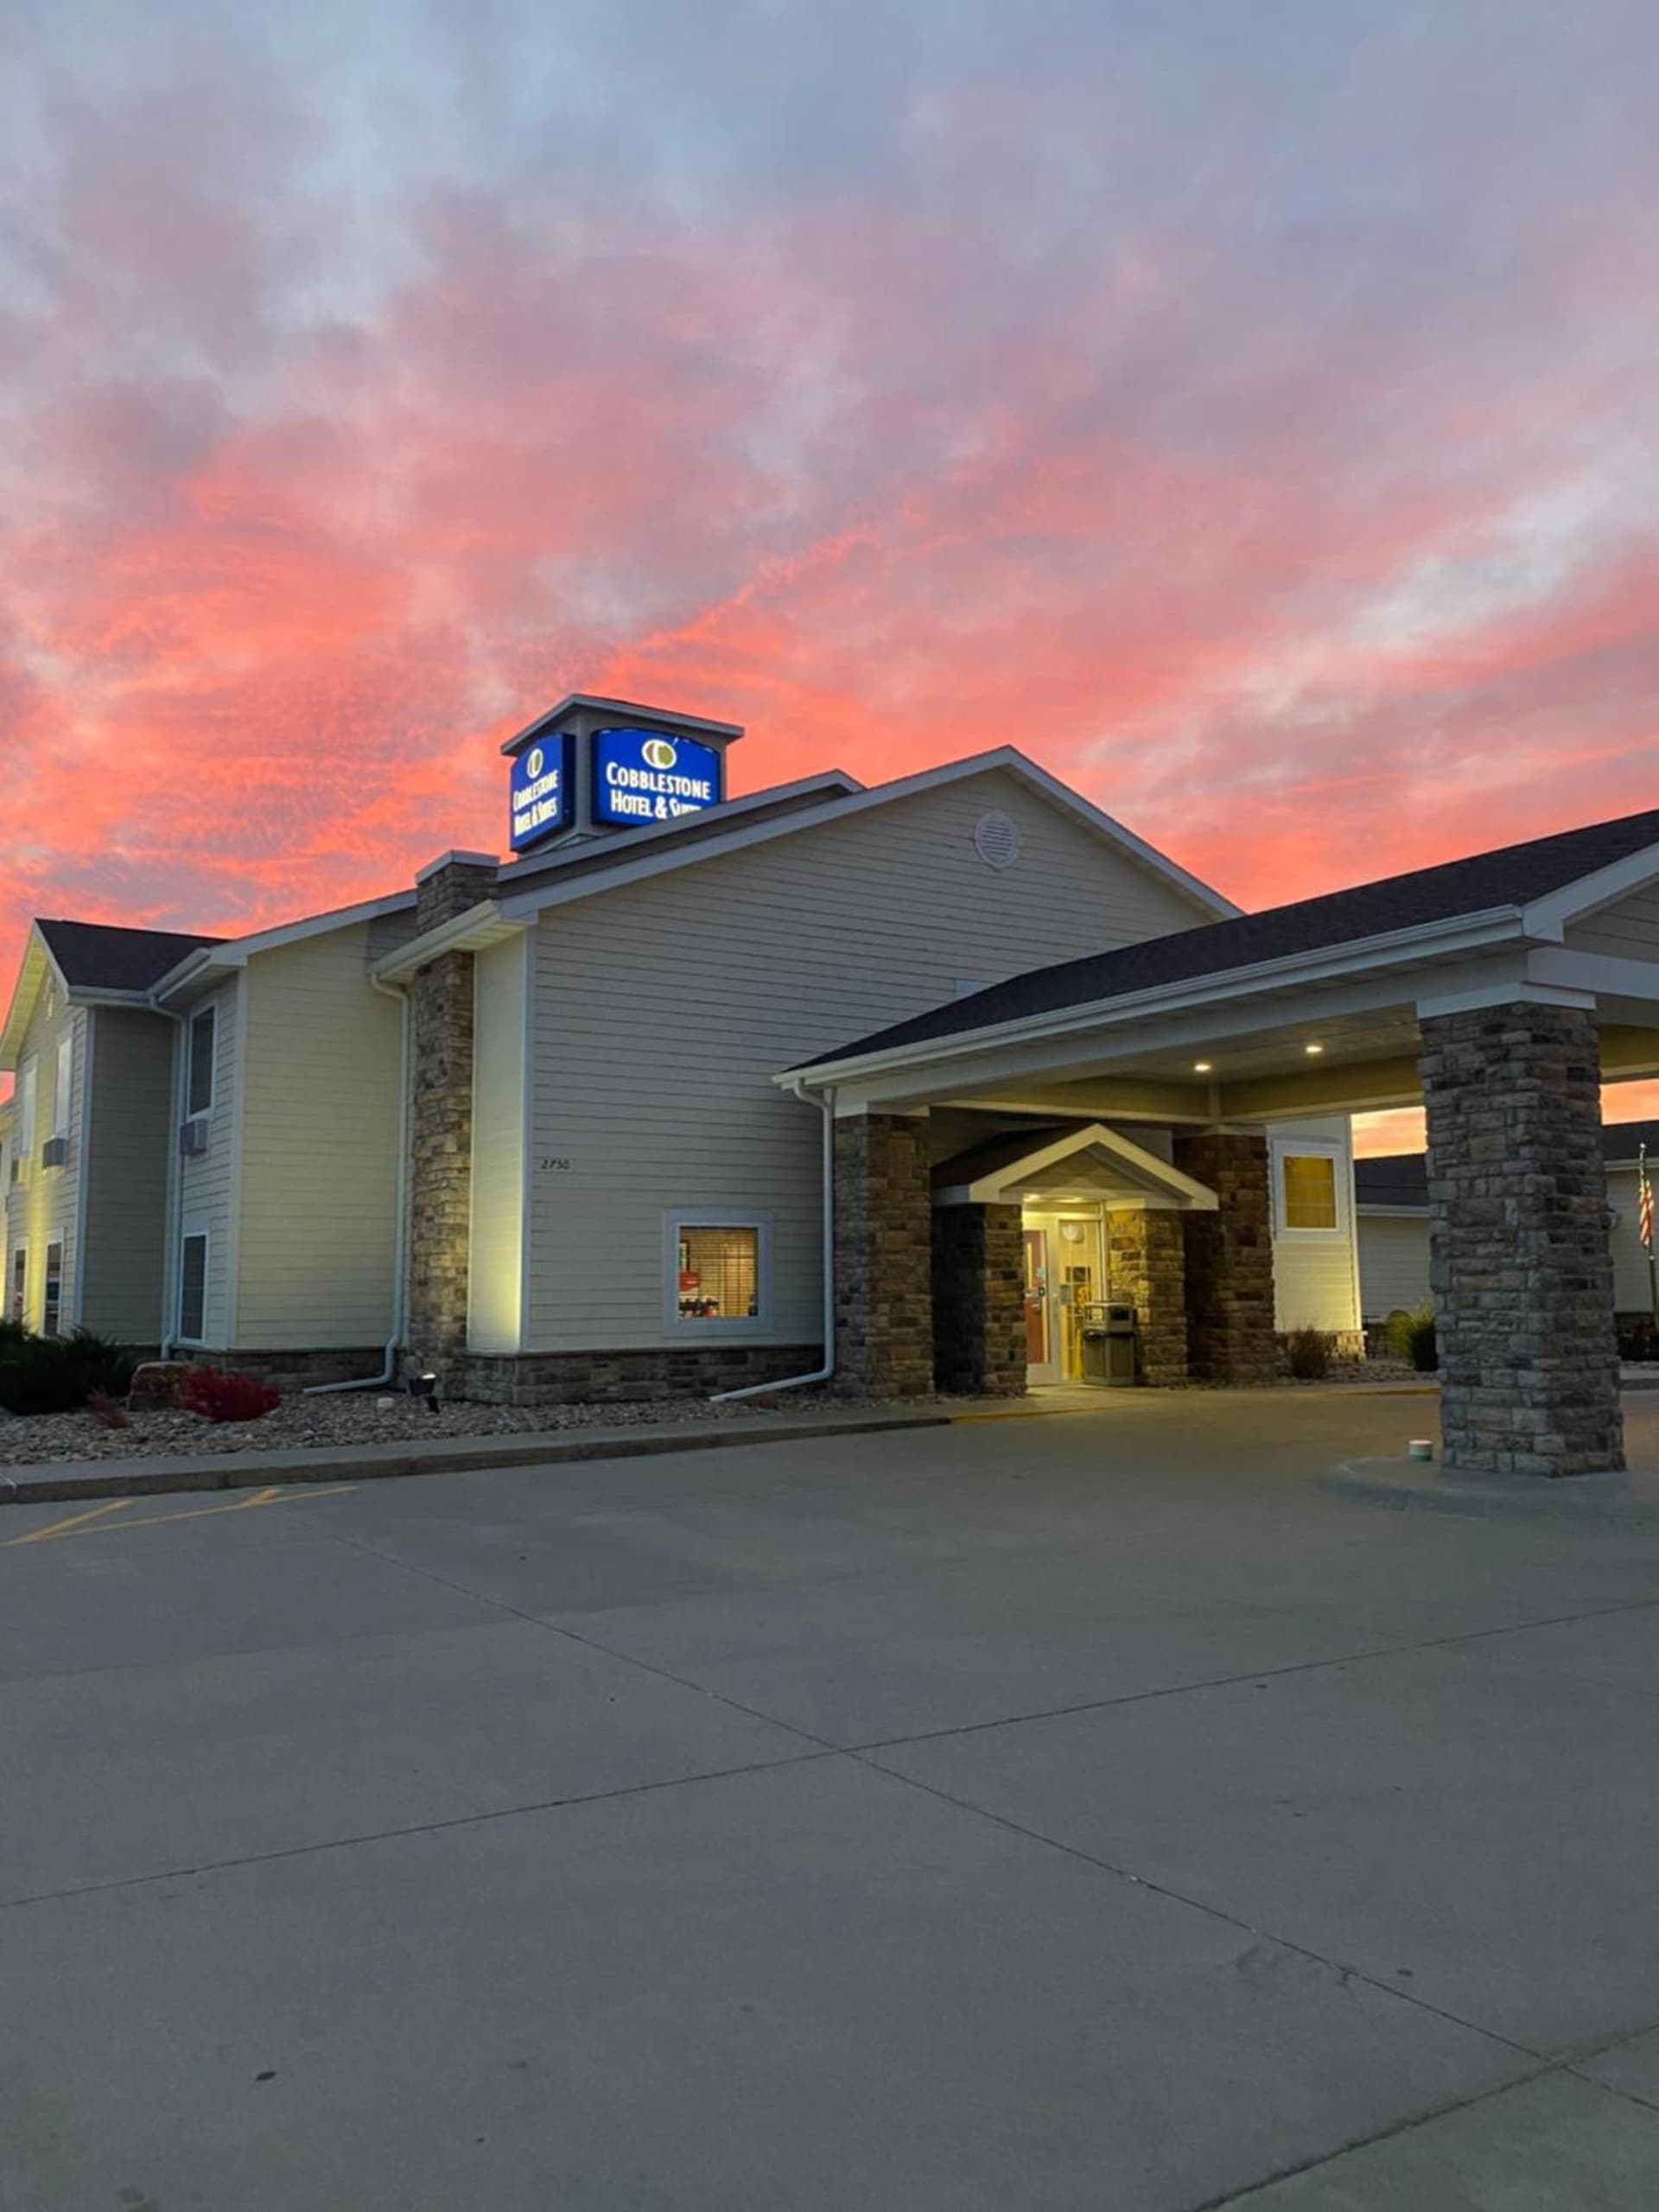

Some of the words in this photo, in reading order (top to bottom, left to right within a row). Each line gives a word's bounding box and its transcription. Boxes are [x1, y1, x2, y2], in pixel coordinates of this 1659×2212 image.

[607, 762, 711, 800] COBBLESTONE
[610, 790, 653, 817] HOTEL
[655, 796, 668, 820] &
